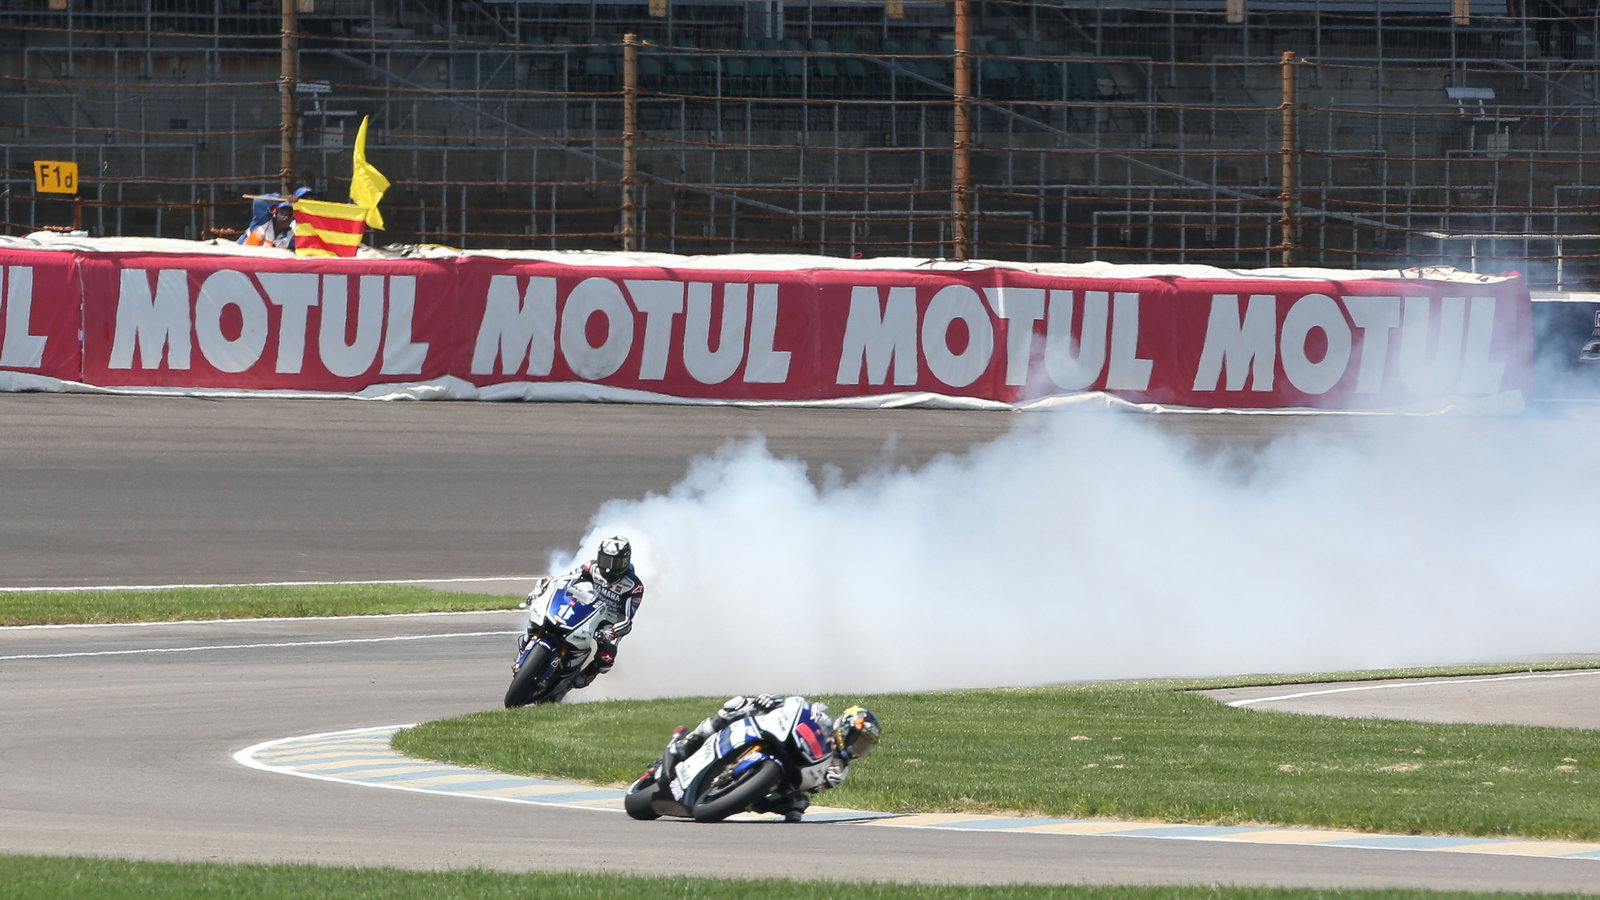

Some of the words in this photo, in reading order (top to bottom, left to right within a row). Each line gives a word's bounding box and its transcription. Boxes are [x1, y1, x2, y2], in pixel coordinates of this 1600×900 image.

[40, 164, 73, 188] F1d
[0, 265, 48, 368] L
[108, 268, 429, 378] MOTUL
[470, 275, 792, 385] MOTUL
[836, 284, 1154, 390] MOTUL
[1192, 293, 1507, 397] MOTUL
[594, 583, 620, 602] YAMAHA
